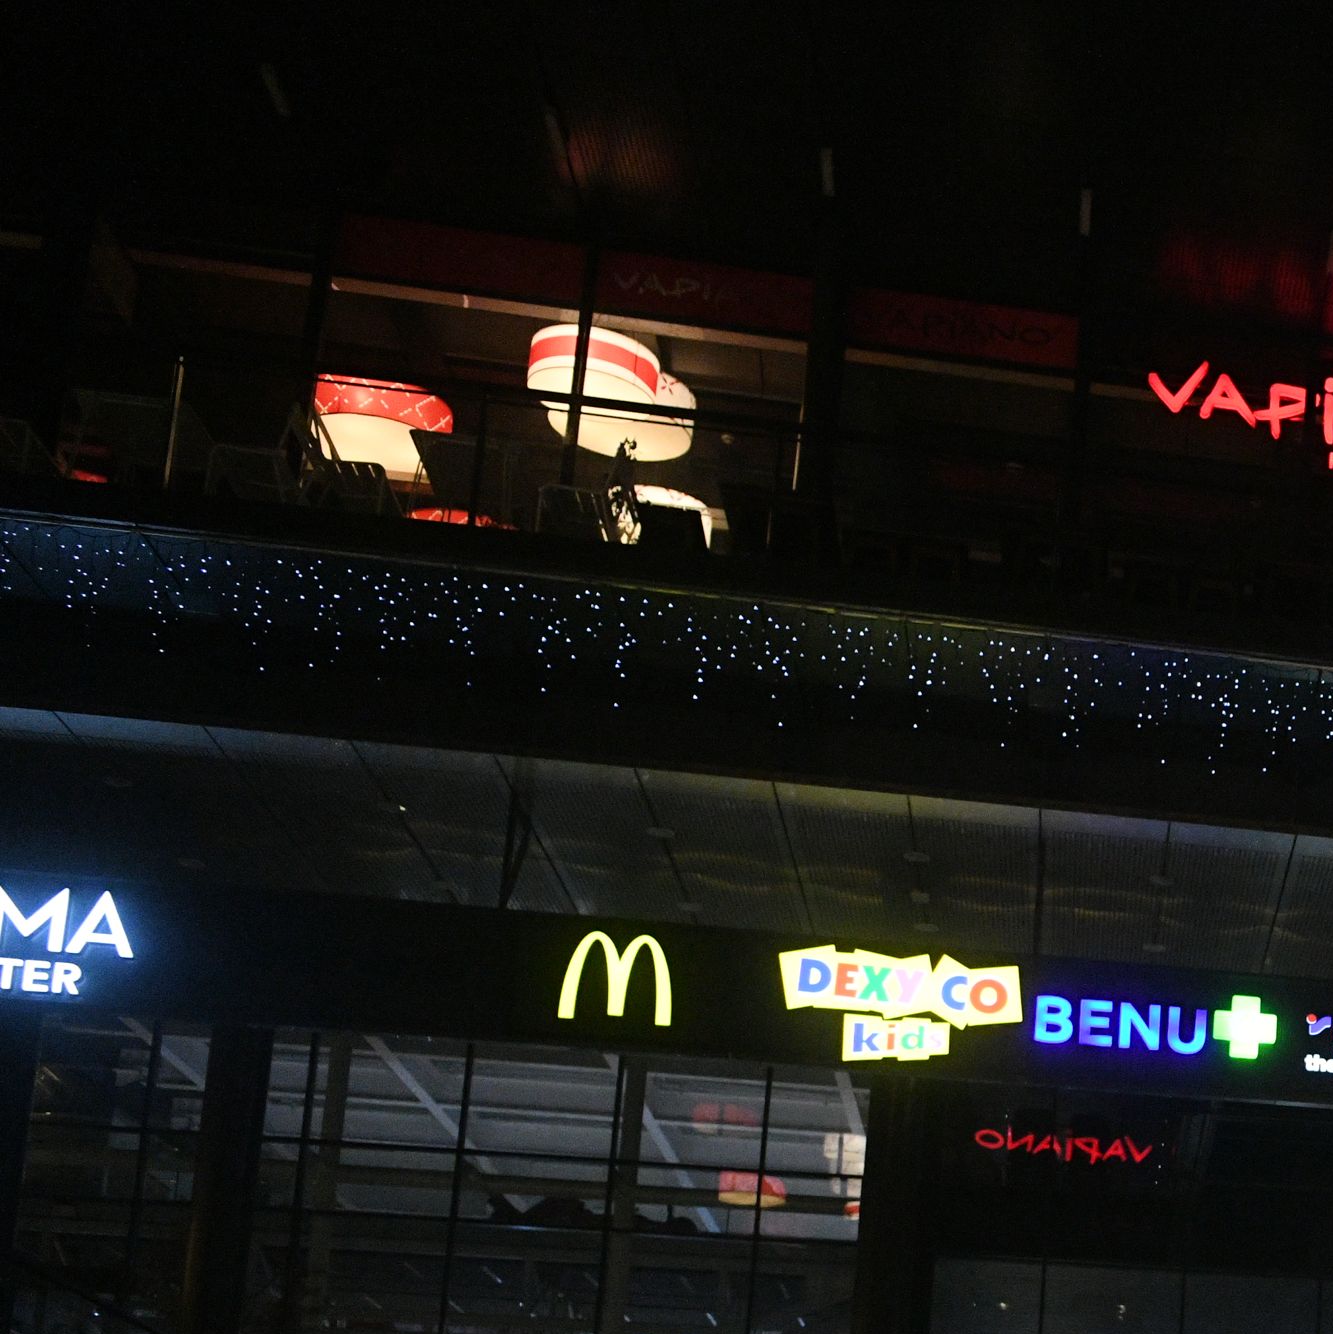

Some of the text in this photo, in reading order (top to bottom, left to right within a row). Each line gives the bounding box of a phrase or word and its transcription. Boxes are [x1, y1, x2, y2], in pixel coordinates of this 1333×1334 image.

[797, 957, 1008, 1014] DEXY CO
[852, 1022, 943, 1052] kids
[1034, 994, 1208, 1055] BENU
